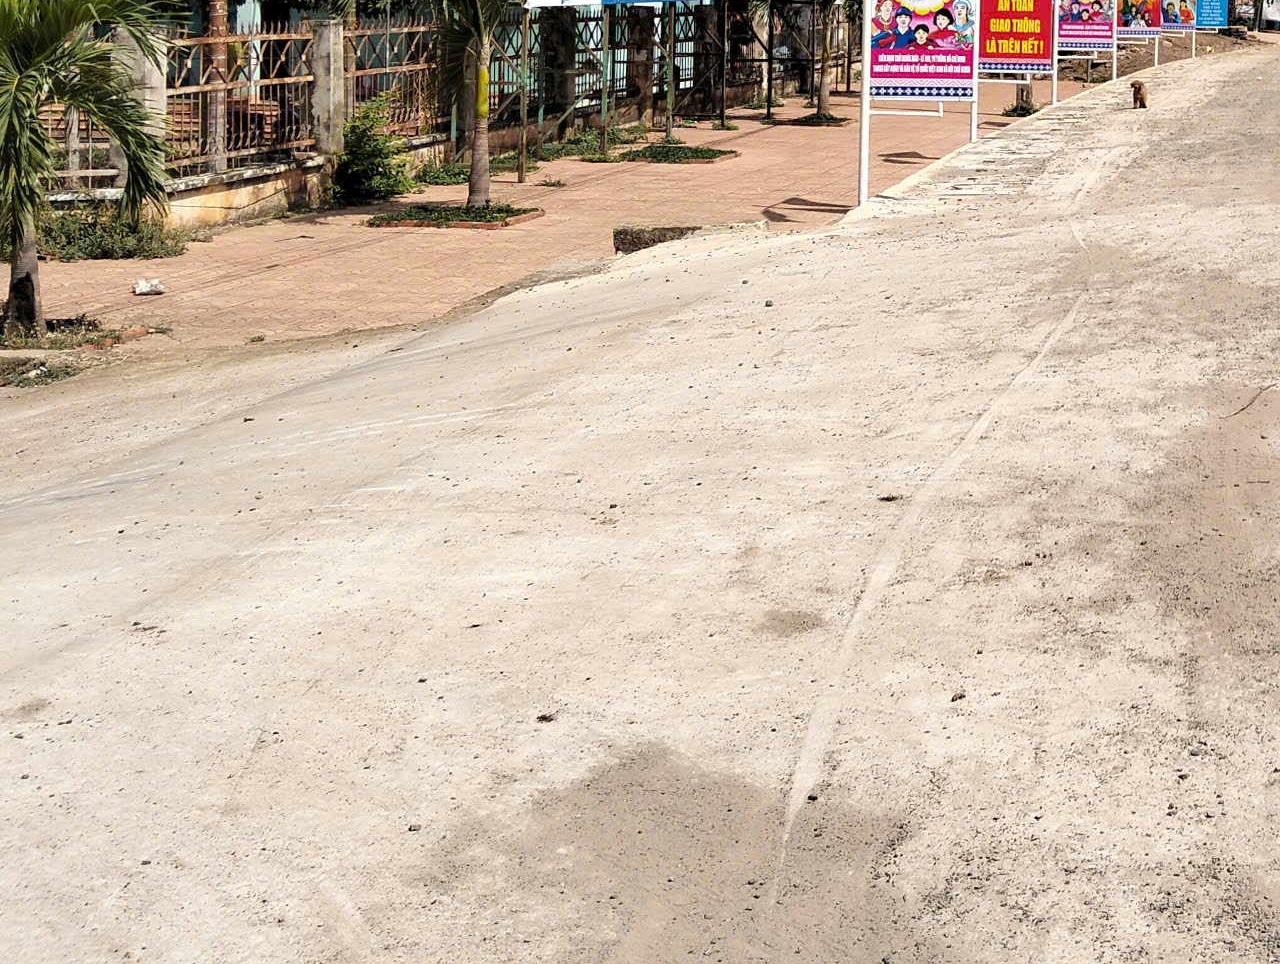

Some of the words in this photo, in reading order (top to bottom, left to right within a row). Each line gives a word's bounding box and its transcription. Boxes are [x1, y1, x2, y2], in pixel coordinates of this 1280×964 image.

[990, 18, 1011, 33] GIAO
[1012, 16, 1041, 33] THÔNG
[986, 36, 997, 53] LÀ
[998, 37, 1021, 54] TRÊN
[1021, 36, 1039, 54] HẾT
